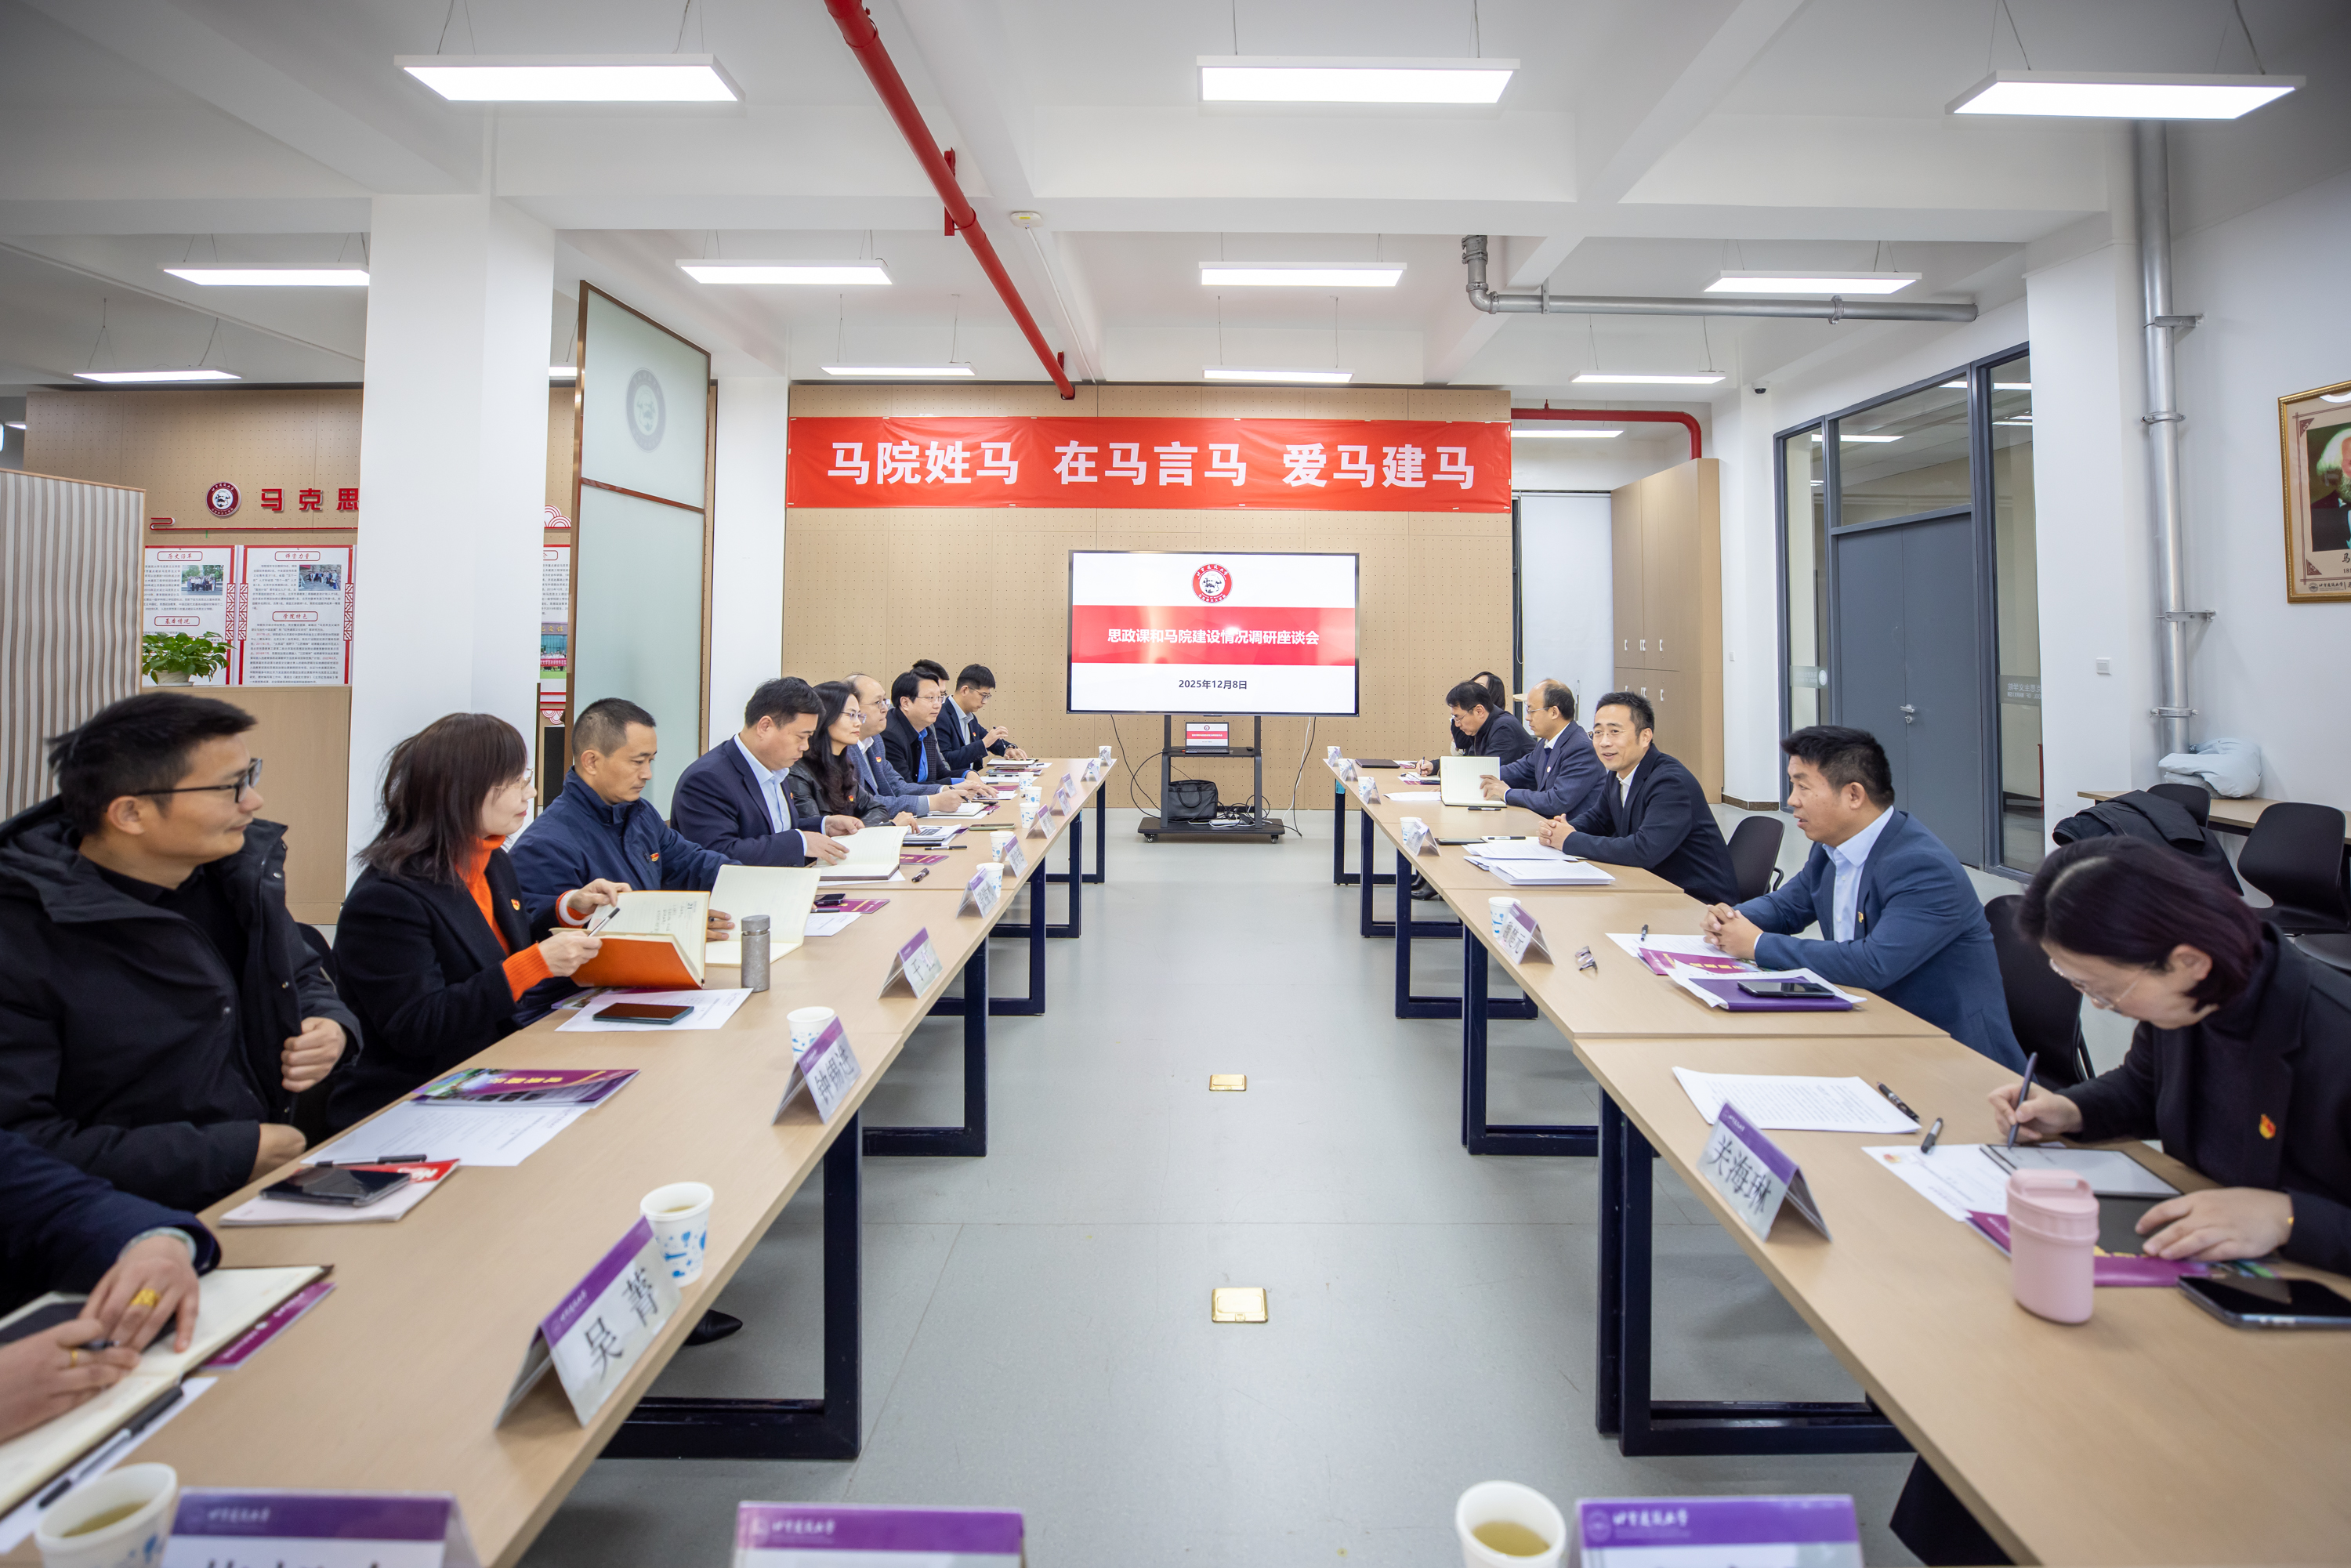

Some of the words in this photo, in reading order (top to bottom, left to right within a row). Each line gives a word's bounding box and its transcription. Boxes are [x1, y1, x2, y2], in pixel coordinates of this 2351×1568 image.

[828, 440, 1019, 484] 马院姓马
[1052, 440, 1247, 486] 在马言马
[1282, 442, 1475, 490] 爱马建马
[261, 487, 360, 512] 马克思
[1107, 628, 1320, 645] 思政课和马院建设情况调研座谈会
[1178, 679, 1248, 690] 2025年12月8日
[584, 1266, 659, 1385] 吴菁
